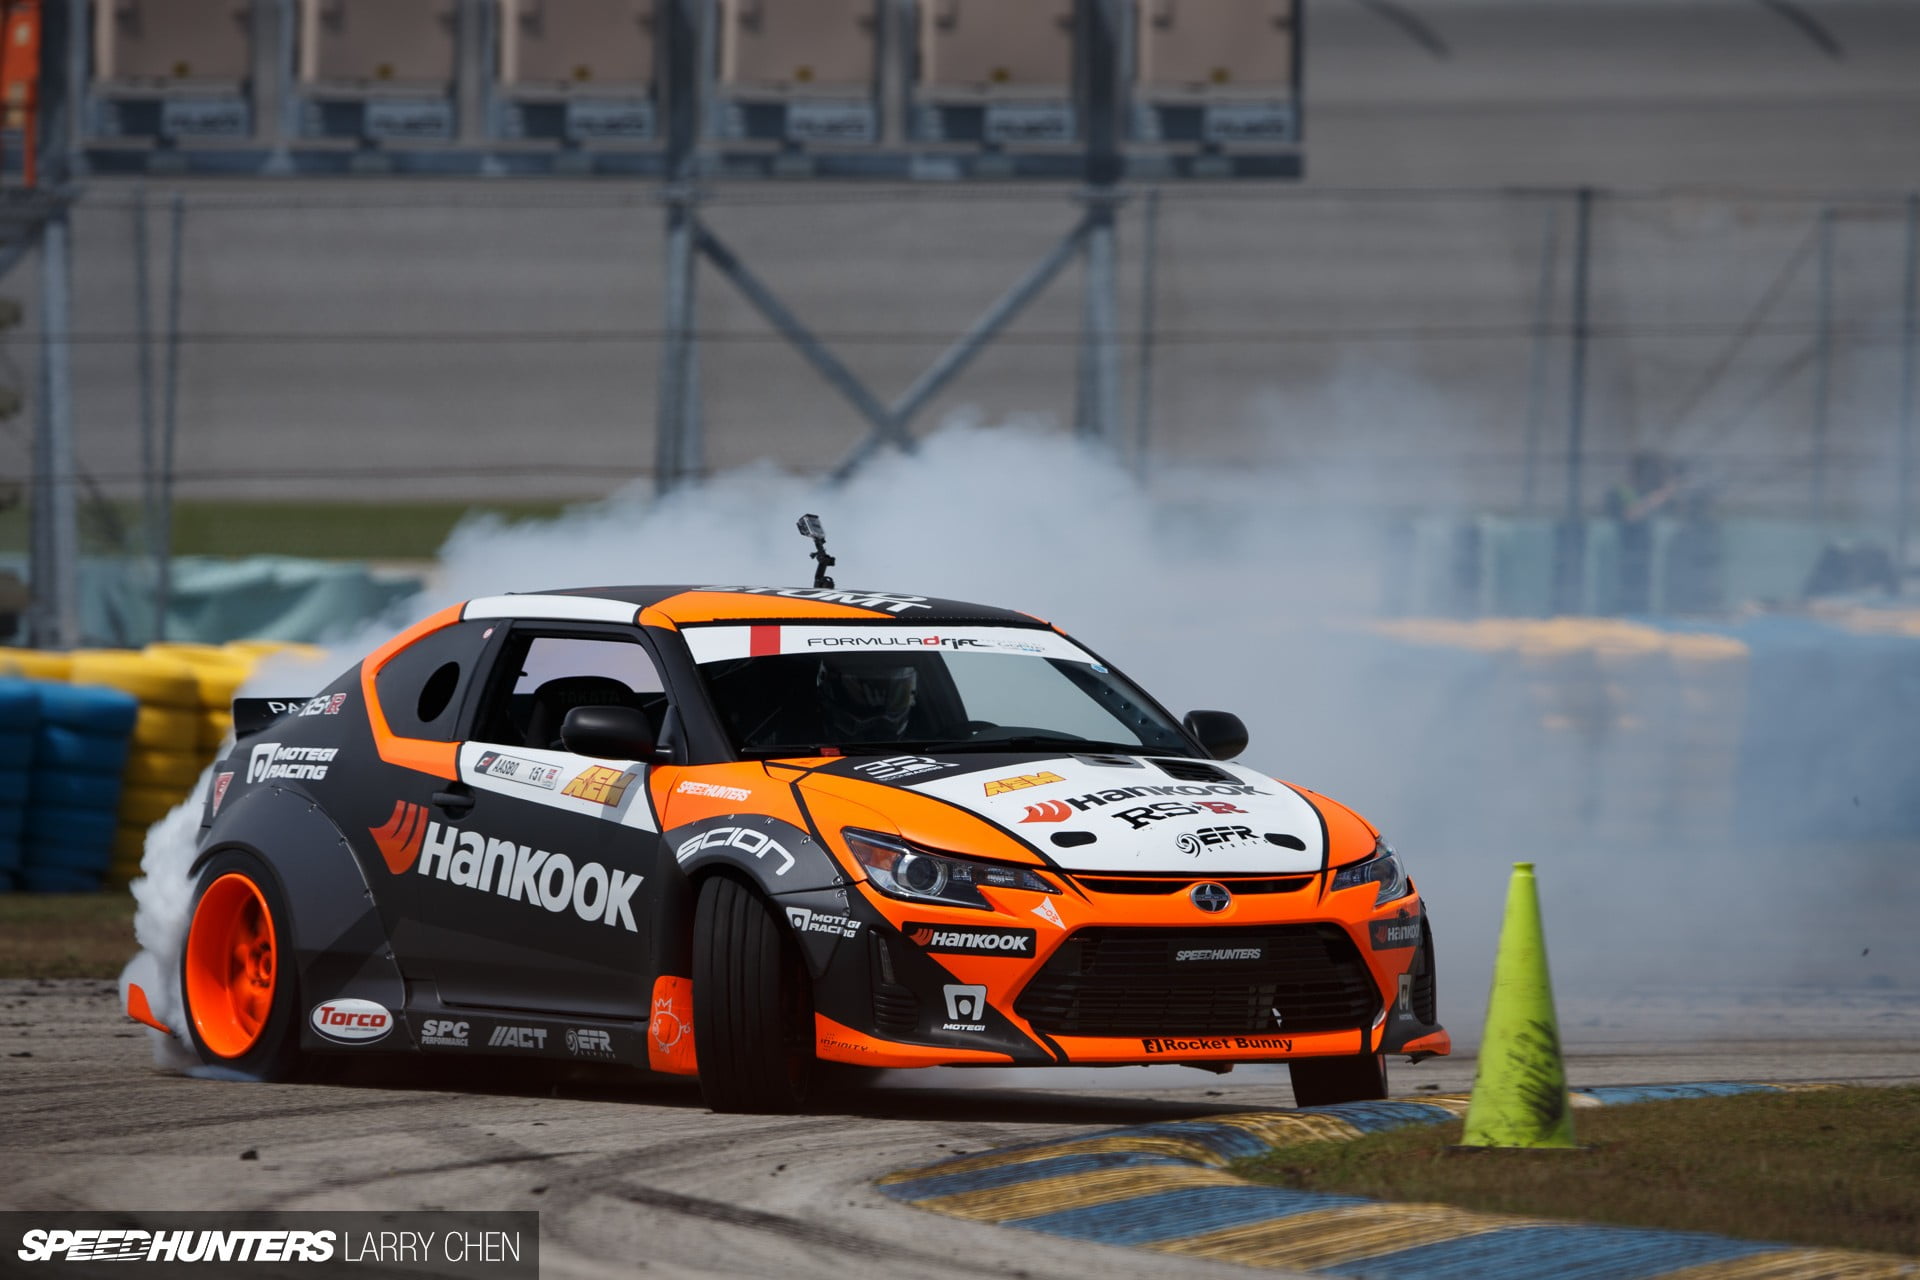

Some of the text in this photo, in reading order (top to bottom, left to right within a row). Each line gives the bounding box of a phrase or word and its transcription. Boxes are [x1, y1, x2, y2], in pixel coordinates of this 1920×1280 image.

[274, 747, 339, 762] MOTEGI
[266, 764, 328, 780] RACING
[492, 759, 520, 776] AASBO
[528, 766, 546, 782] 151
[560, 764, 638, 808] AEM
[677, 780, 752, 802] SPEEDHUNTERS
[983, 770, 1067, 797] AEM
[1196, 825, 1261, 847] EFR
[811, 912, 862, 929] MOTEGI
[1175, 948, 1262, 962] SPEEDHUNTERS
[320, 1006, 387, 1028] Torco
[421, 1019, 470, 1037] SPC
[942, 1023, 986, 1032] MOTEGI
[577, 1029, 613, 1052] EFR
[1163, 1037, 1293, 1052] Rocket Bunny
